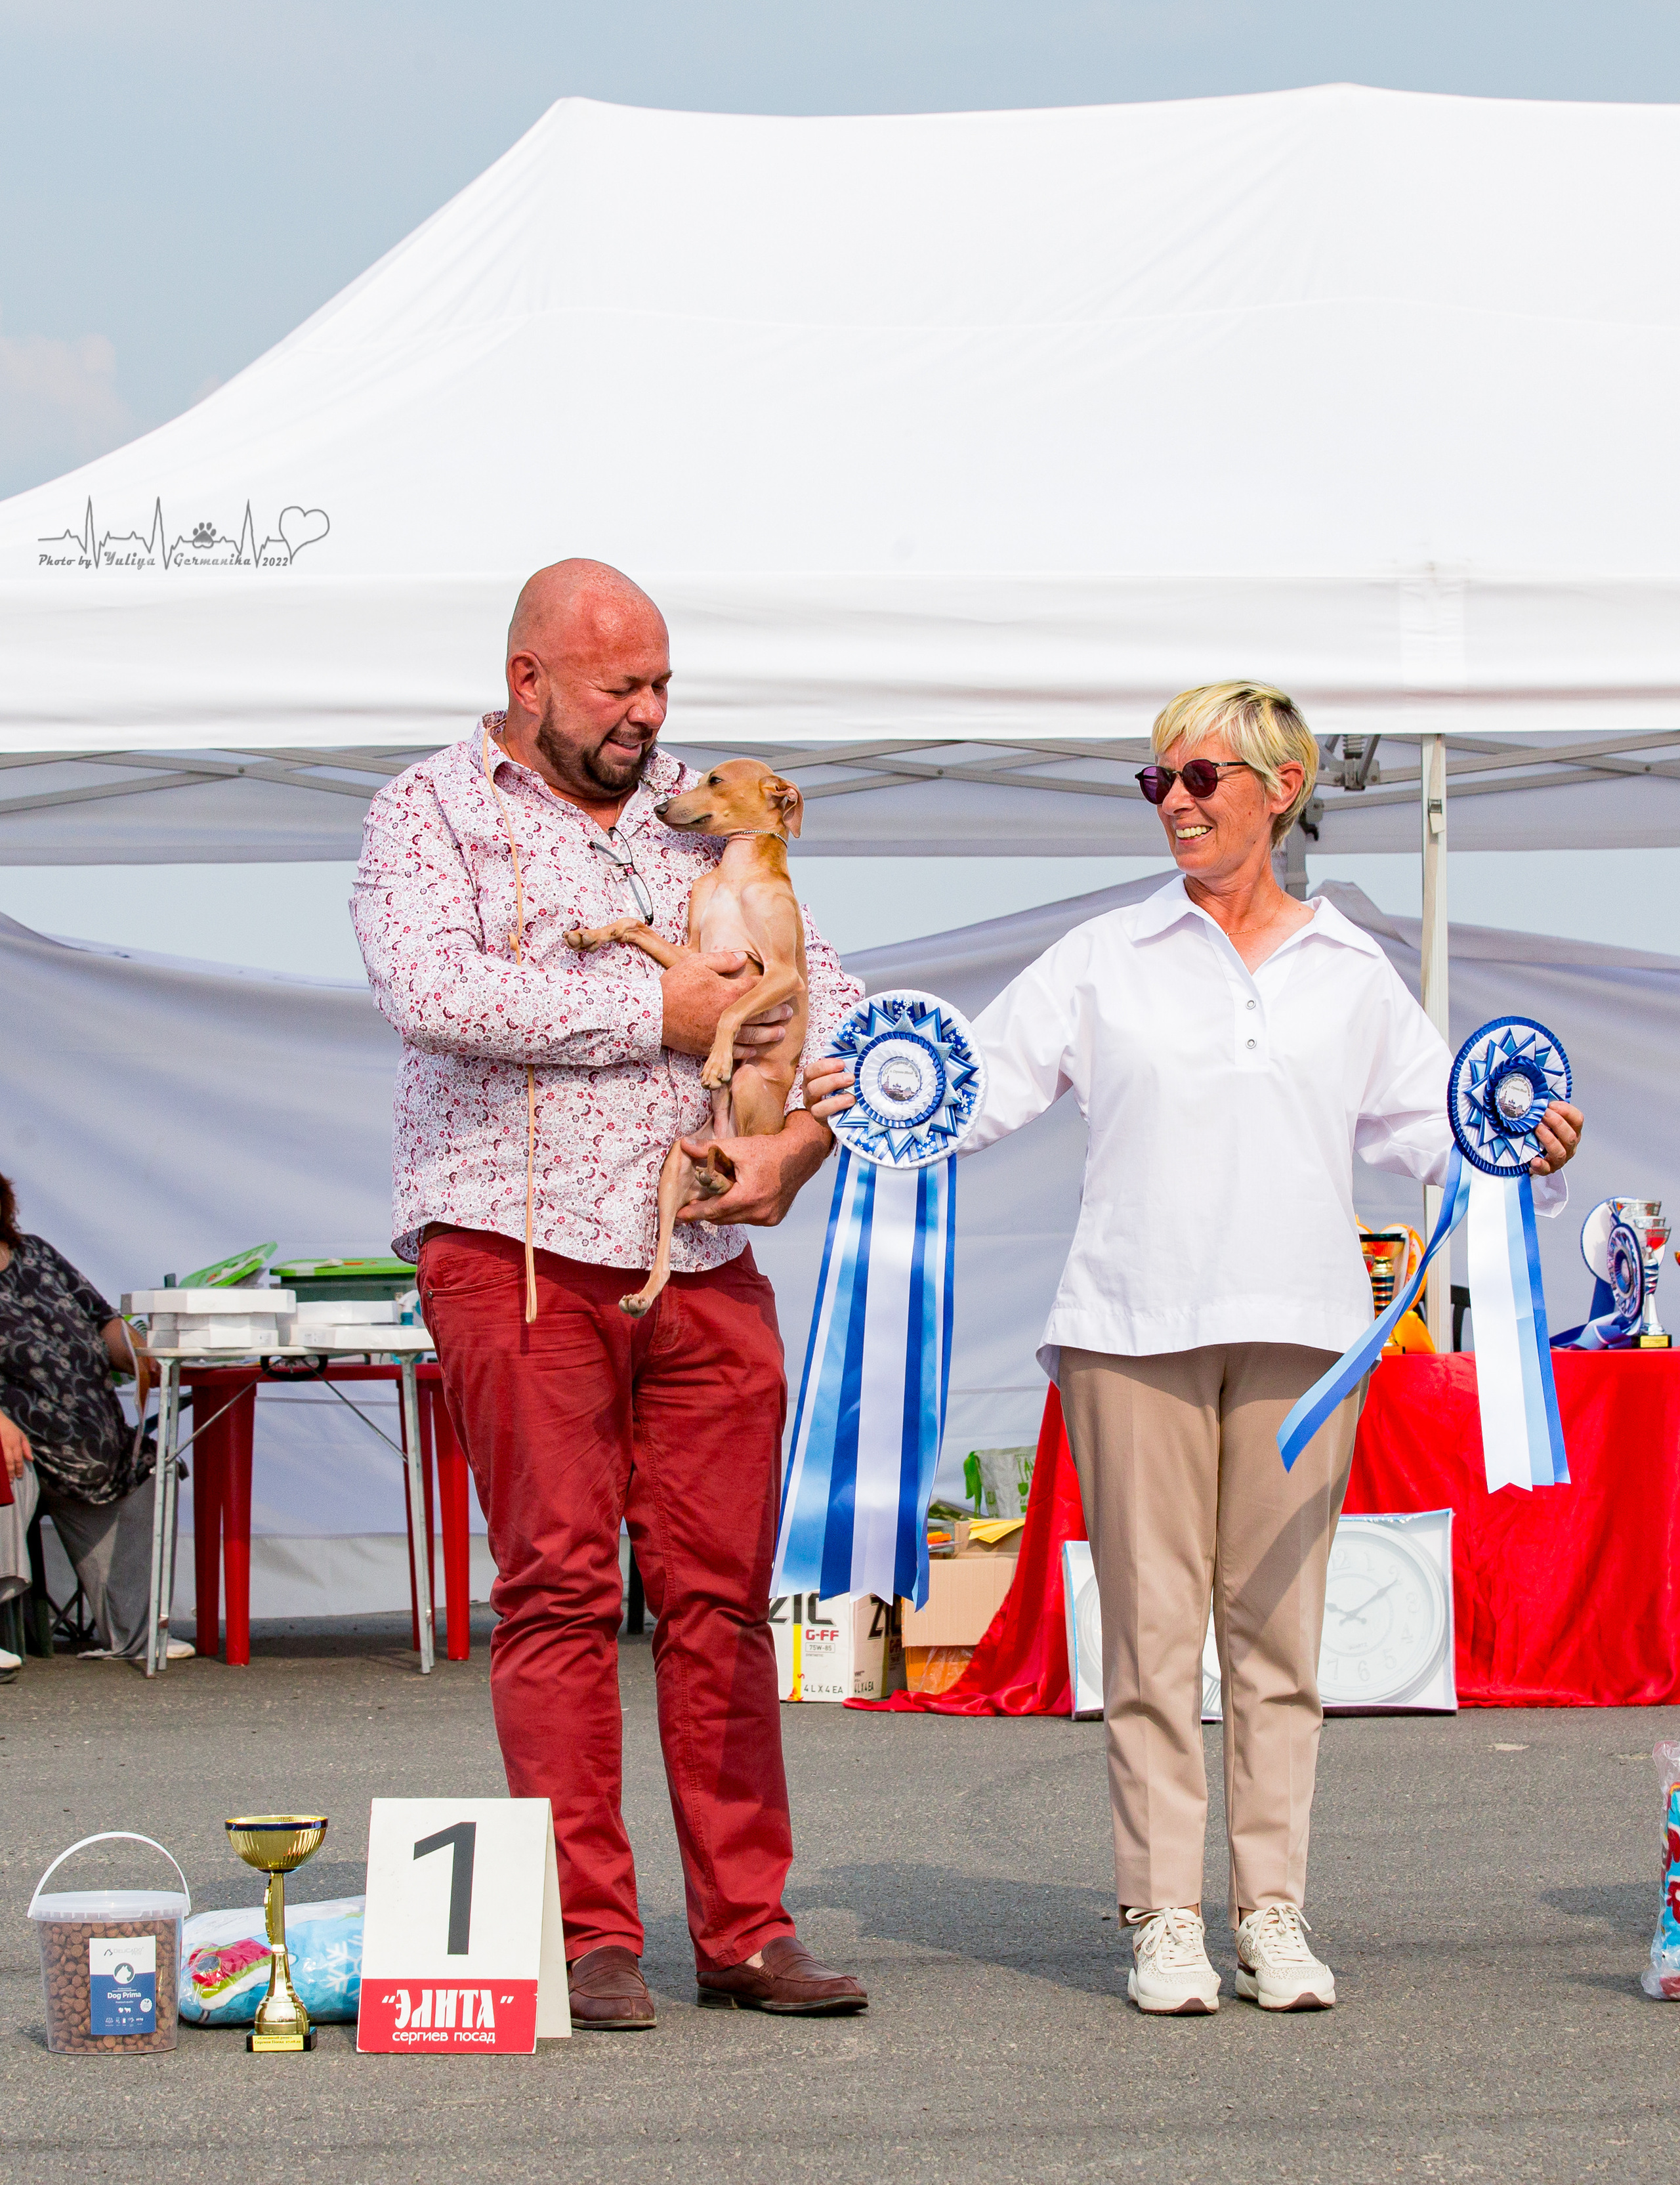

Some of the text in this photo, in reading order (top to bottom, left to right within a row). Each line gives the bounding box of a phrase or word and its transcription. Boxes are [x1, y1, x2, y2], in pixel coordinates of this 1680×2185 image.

[1364, 1552, 1375, 1571] 1
[1406, 1592, 1420, 1613] 3
[805, 1629, 839, 1641] G-FF
[1383, 1647, 1397, 1670] 5
[1358, 1660, 1370, 1682] 6
[833, 1685, 843, 1694] EA
[413, 1821, 477, 1955] 1
[392, 2031, 495, 2045] сергиев посад
